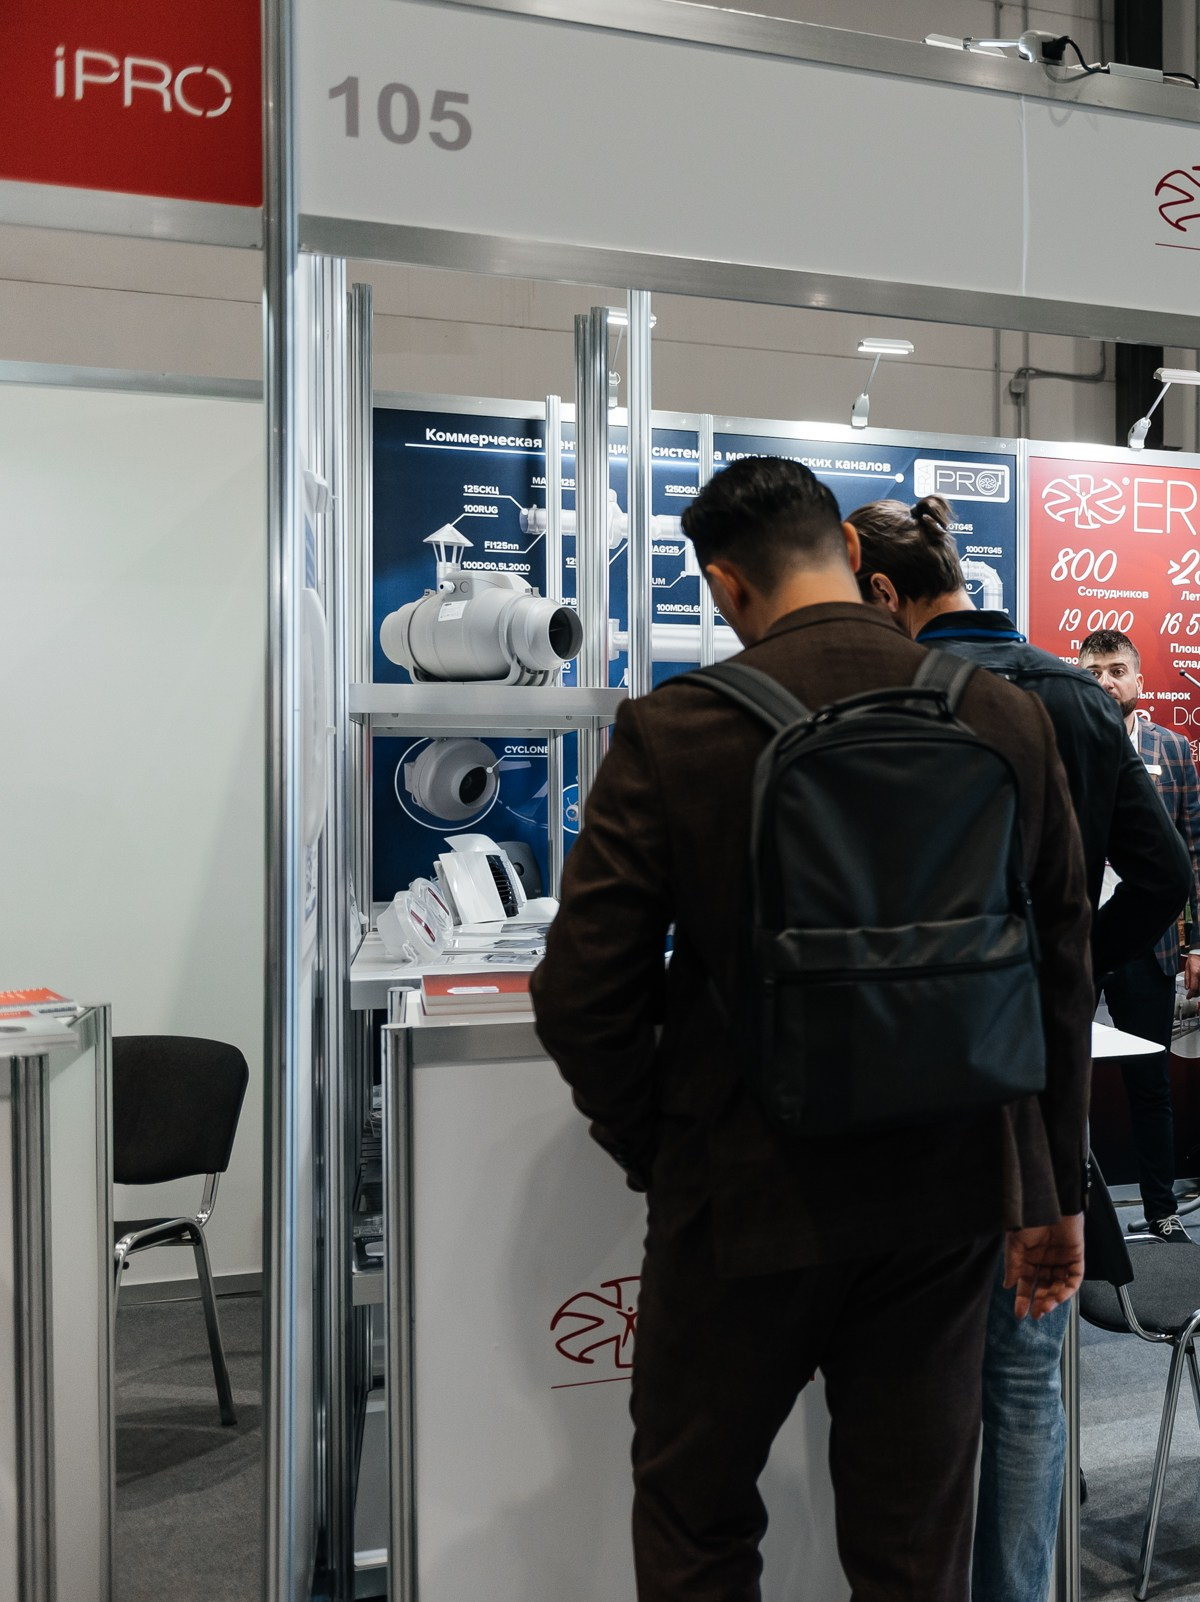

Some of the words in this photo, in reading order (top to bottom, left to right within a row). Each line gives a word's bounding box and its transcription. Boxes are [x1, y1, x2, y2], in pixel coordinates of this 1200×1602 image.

[54, 45, 233, 118] iPRO
[328, 76, 472, 152] 105
[425, 428, 542, 449] Коммерческая
[835, 459, 891, 473] каналов
[463, 504, 499, 514] 100RUG
[1050, 548, 1118, 583] 800
[1077, 586, 1149, 600] Сотрудников
[1181, 590, 1200, 602] Лет
[1058, 608, 1082, 632] 19
[1086, 609, 1135, 634] 000
[1159, 612, 1183, 636] 16
[1157, 691, 1191, 702] марок
